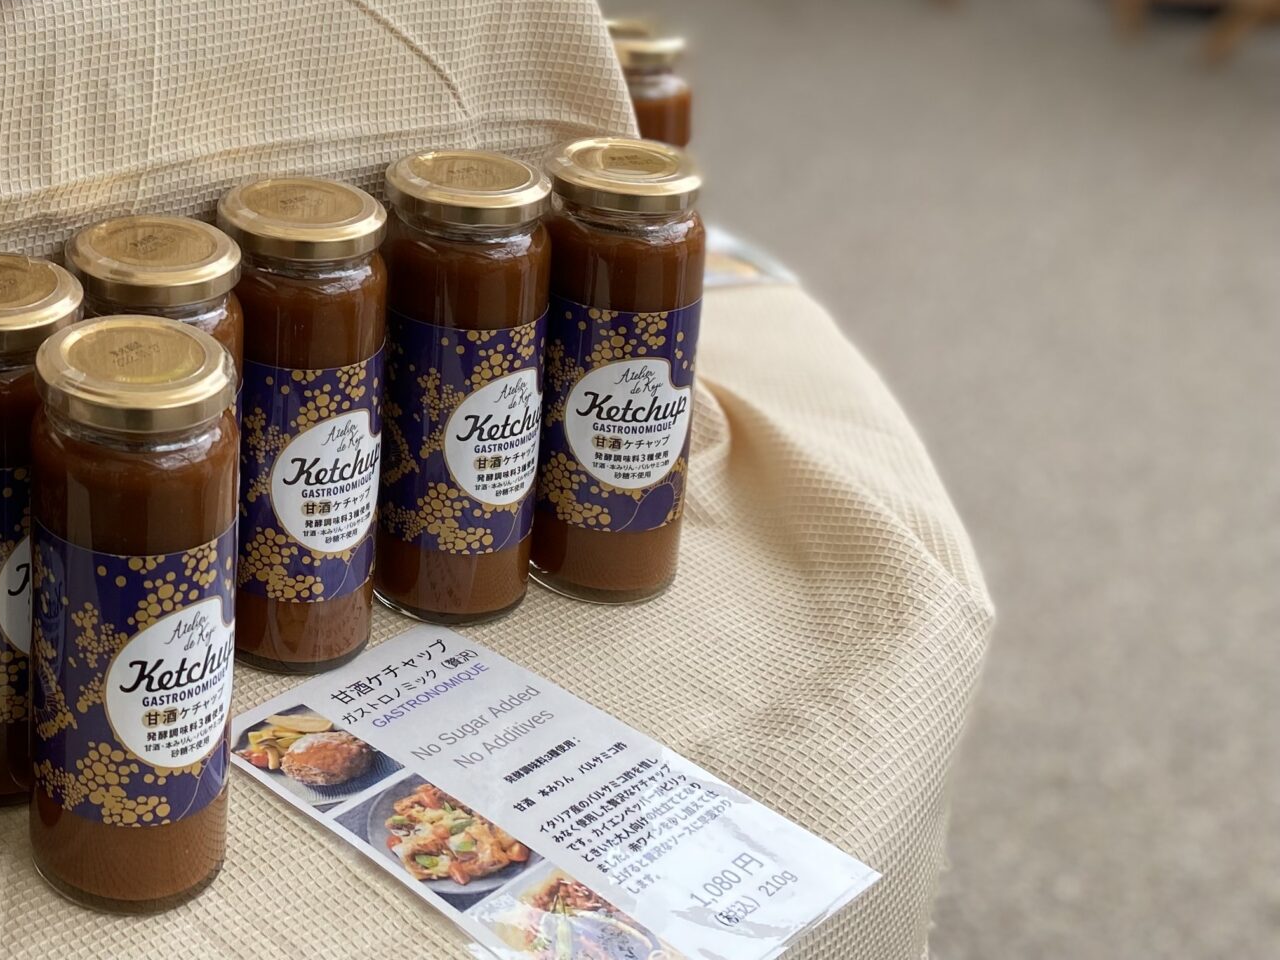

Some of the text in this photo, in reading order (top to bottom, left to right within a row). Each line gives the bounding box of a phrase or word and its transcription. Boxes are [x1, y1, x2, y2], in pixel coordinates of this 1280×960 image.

[614, 365, 656, 385] Atelier
[630, 381, 641, 394] de
[456, 406, 541, 442] Ketchu
[575, 391, 687, 425] Ketchup
[592, 421, 672, 435] GASTRONOMIQUE
[594, 434, 671, 450] 甘酒ケチャップ
[594, 450, 669, 463] 発酵調味料3種使用
[302, 472, 372, 498] GASTRONOMIQUE
[614, 471, 651, 480] 砂糖不使用
[304, 485, 371, 515] 甘酒ケチャップ
[325, 528, 358, 544] 砂糖不使用
[184, 636, 194, 651] de
[142, 668, 226, 707] GASTRONOMIQUE
[330, 638, 447, 705] 甘酒ケチャップ
[146, 683, 225, 726] 甘酒ケチャップ
[372, 662, 490, 729] GASTRONOMIQUE
[147, 703, 224, 741] 発酵調味料3種使用
[410, 684, 541, 761] No Sugar Added
[453, 709, 554, 769] No Additives
[171, 736, 210, 758] 砂糖不使用
[513, 741, 628, 812] 甘酒 本みりん バルサミコ酢
[539, 756, 659, 833] イタリア産のバルサミコ酢を惜し
[552, 763, 671, 844] みなく使用した贅沢なケチャップ
[581, 782, 702, 863] ときいた大人向けの仕立てとなり
[690, 870, 741, 907] 1,080
[758, 870, 798, 897] 210g
